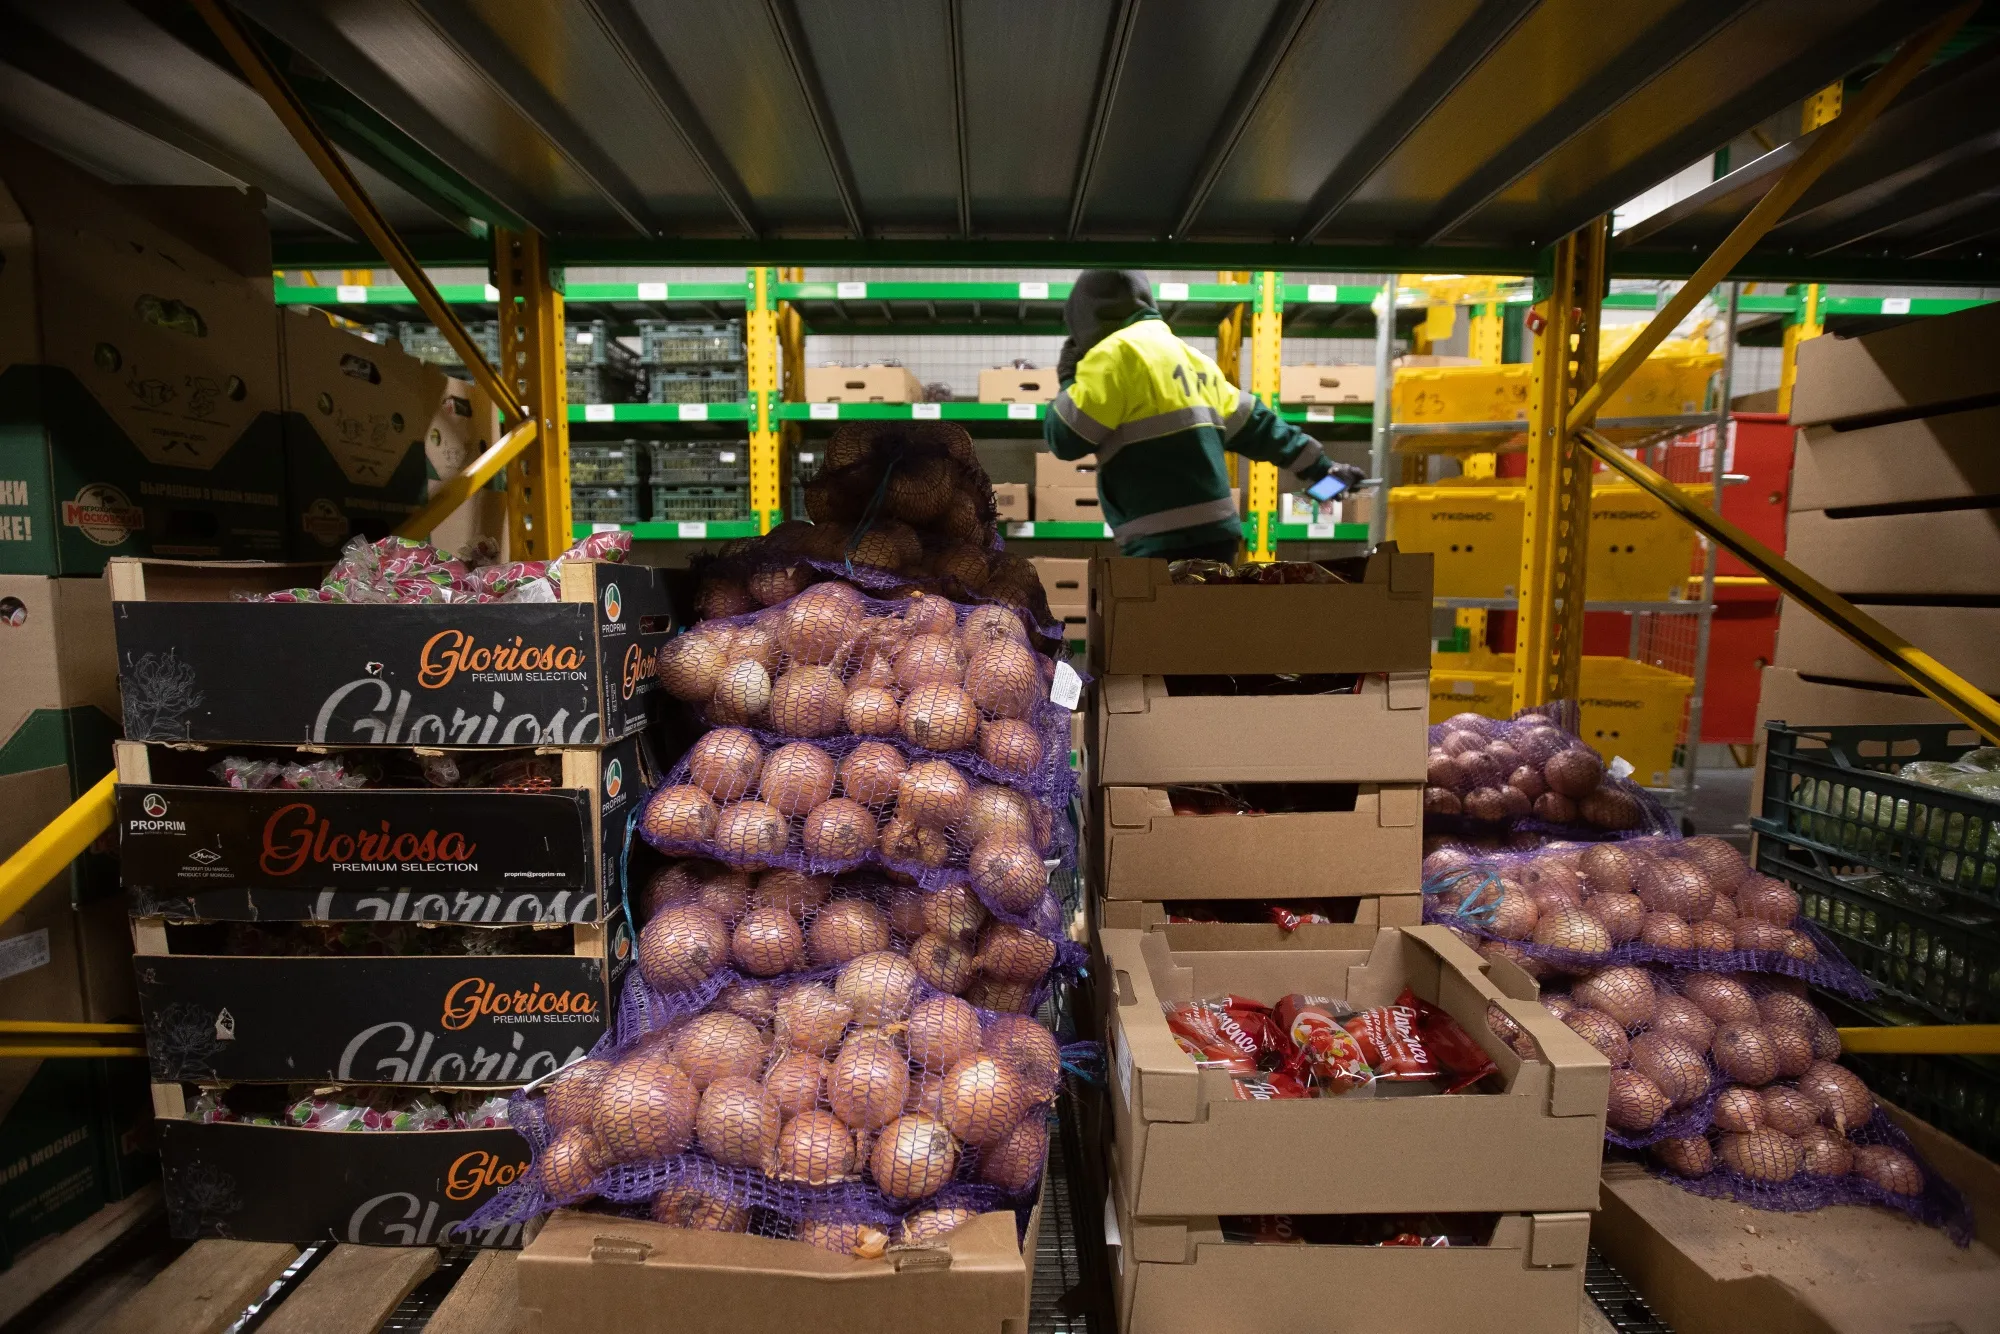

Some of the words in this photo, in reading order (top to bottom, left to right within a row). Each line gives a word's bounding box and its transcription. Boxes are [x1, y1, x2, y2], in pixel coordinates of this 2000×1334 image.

[602, 623, 626, 633] PROPRIM
[417, 629, 587, 689] Gloriosa
[471, 672, 523, 682] PREMIUM
[525, 671, 587, 682] SELECTION
[602, 792, 627, 811] PROPRIM
[130, 820, 186, 831] PROPRIM
[258, 803, 477, 877] Gloriosa
[332, 863, 397, 872] PREMIUM
[400, 863, 478, 872] SELECTION
[441, 976, 598, 1030] Gloriosa
[493, 1014, 541, 1024] PREMIUM
[543, 1014, 600, 1024] SELECTION
